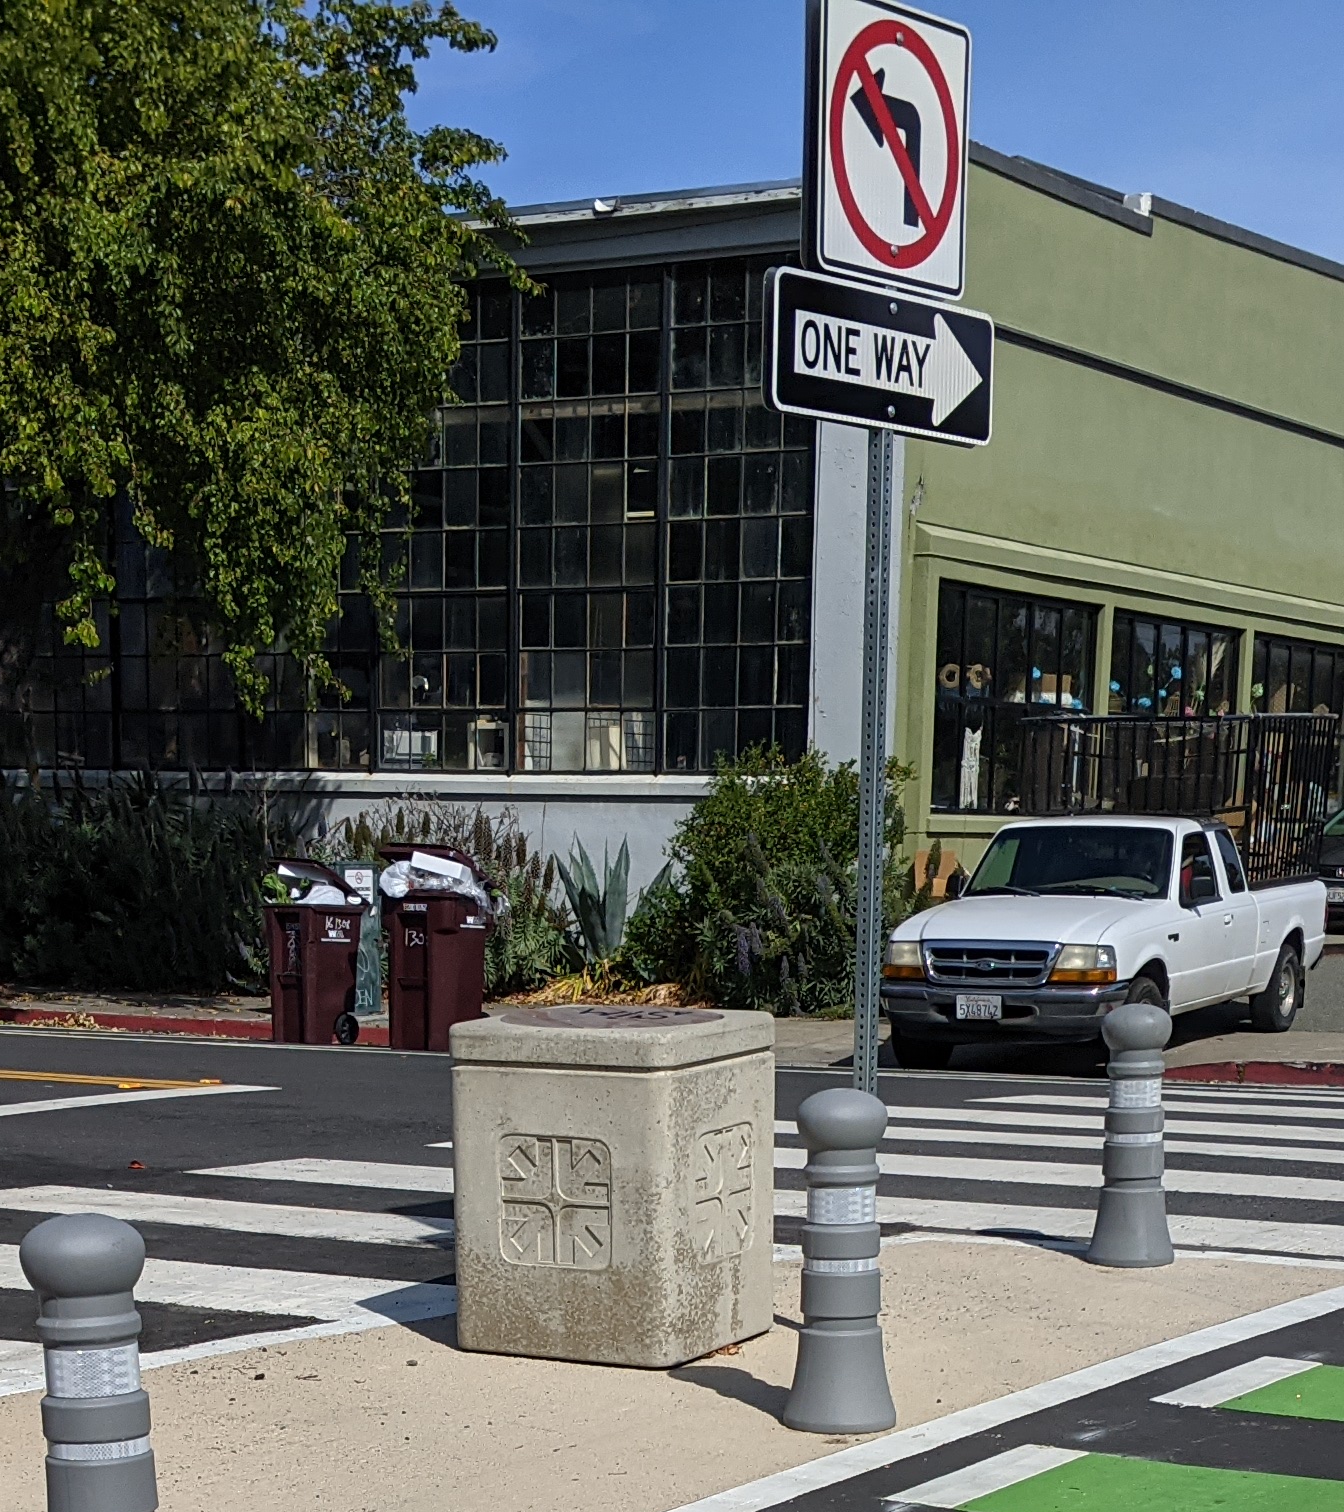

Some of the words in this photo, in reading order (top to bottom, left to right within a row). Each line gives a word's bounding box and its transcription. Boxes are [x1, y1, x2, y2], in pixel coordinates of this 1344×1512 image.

[800, 318, 861, 378] ONE
[873, 332, 932, 389] WAY
[958, 1003, 999, 1017] 5X48742
